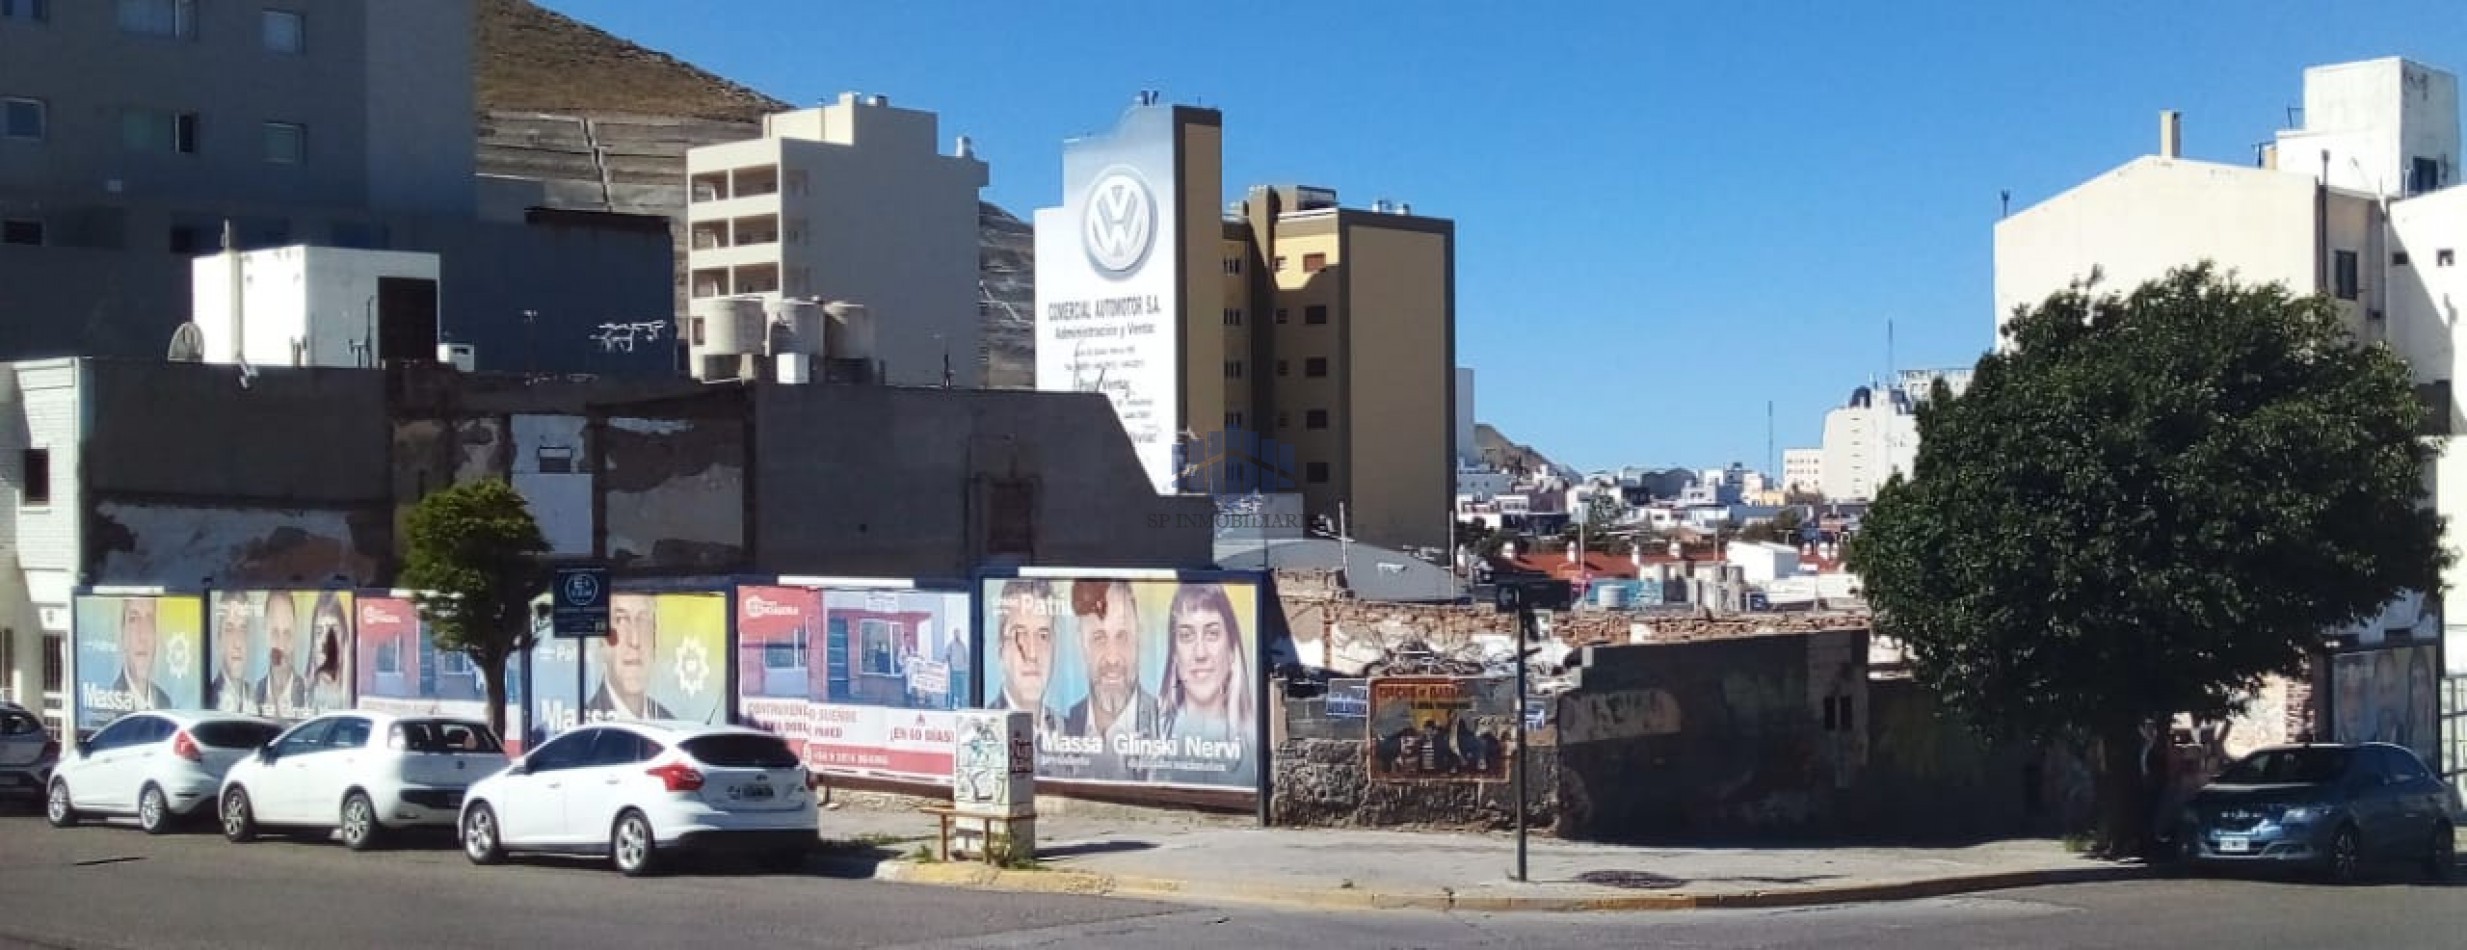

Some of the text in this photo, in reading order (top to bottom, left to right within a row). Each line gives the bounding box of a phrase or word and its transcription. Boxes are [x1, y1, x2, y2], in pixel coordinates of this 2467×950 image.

[1048, 300, 1091, 321] COMERCIAL
[1094, 295, 1143, 319] AUTOMOTOR
[82, 681, 132, 710] Massa
[541, 699, 616, 733] Masa
[1041, 731, 1241, 759] Massa Glinski Nervi
